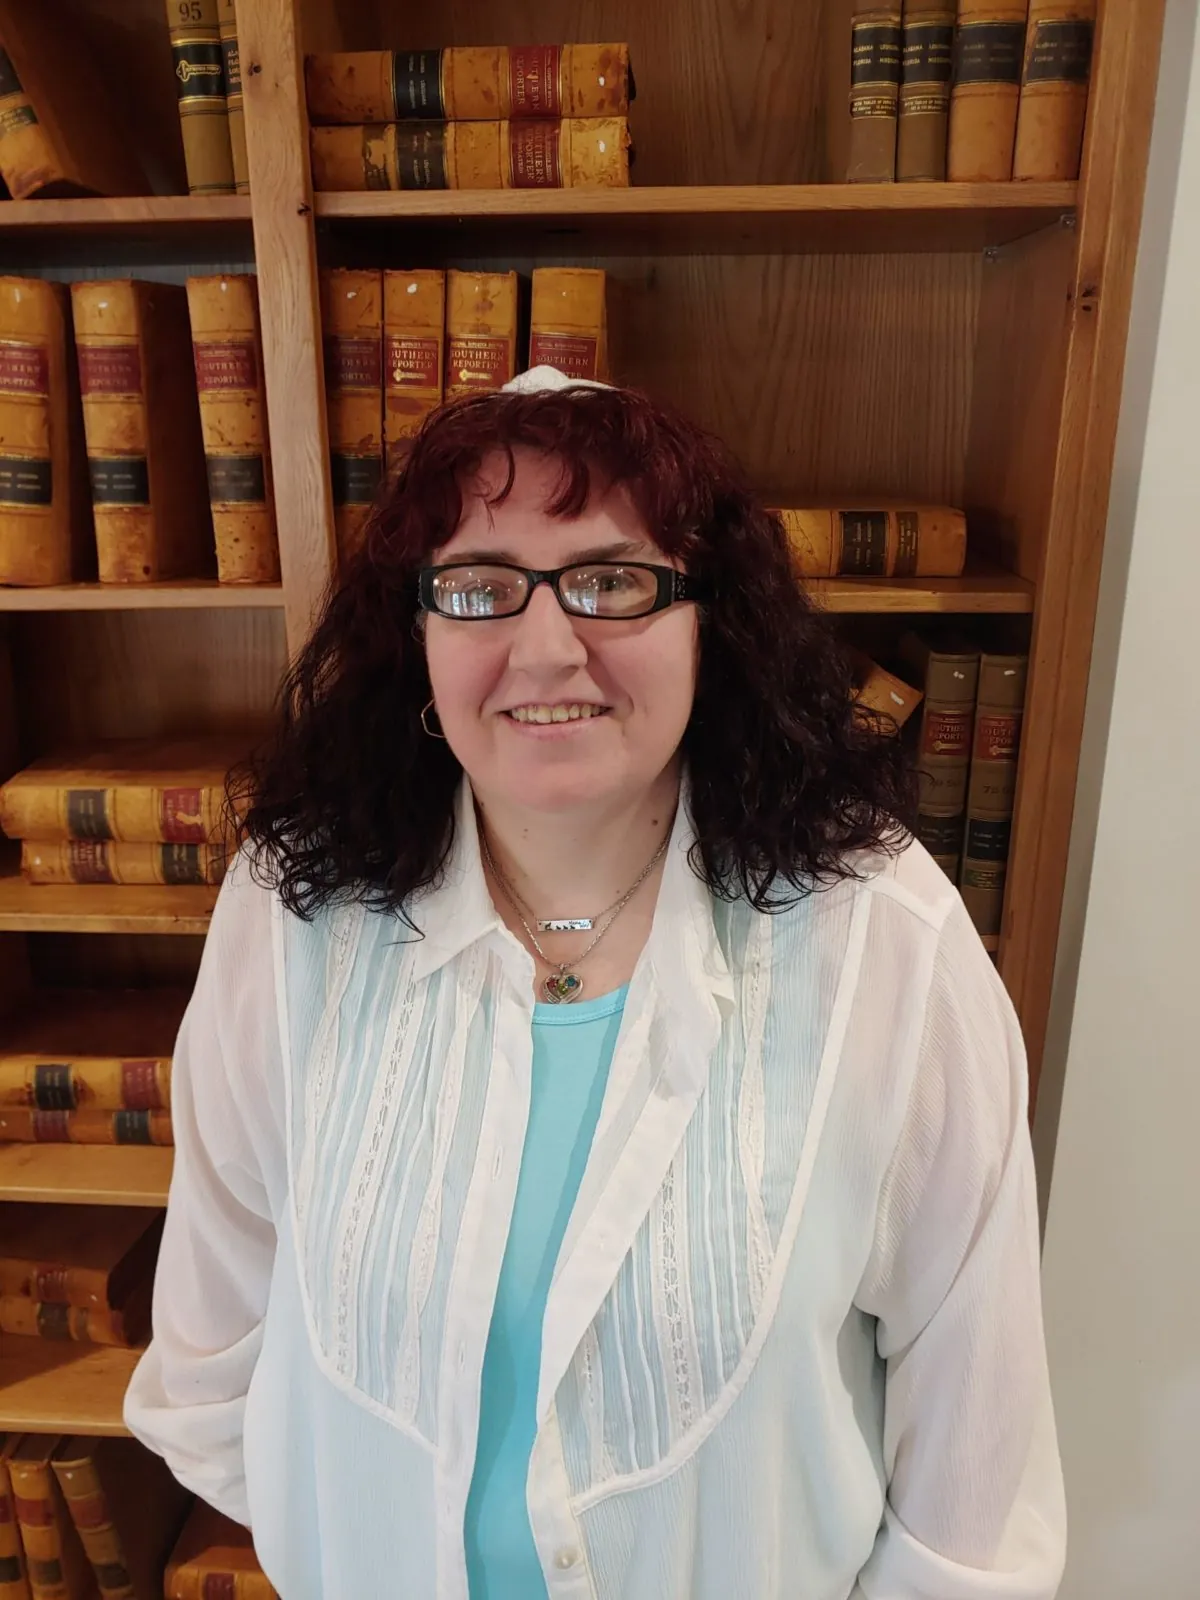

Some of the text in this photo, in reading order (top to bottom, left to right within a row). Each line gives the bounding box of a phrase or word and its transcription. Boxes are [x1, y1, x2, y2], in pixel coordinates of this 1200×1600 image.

[178, 1, 202, 21] 95
[453, 359, 500, 370] REPORTER
[535, 354, 589, 366] SOUTHERN
